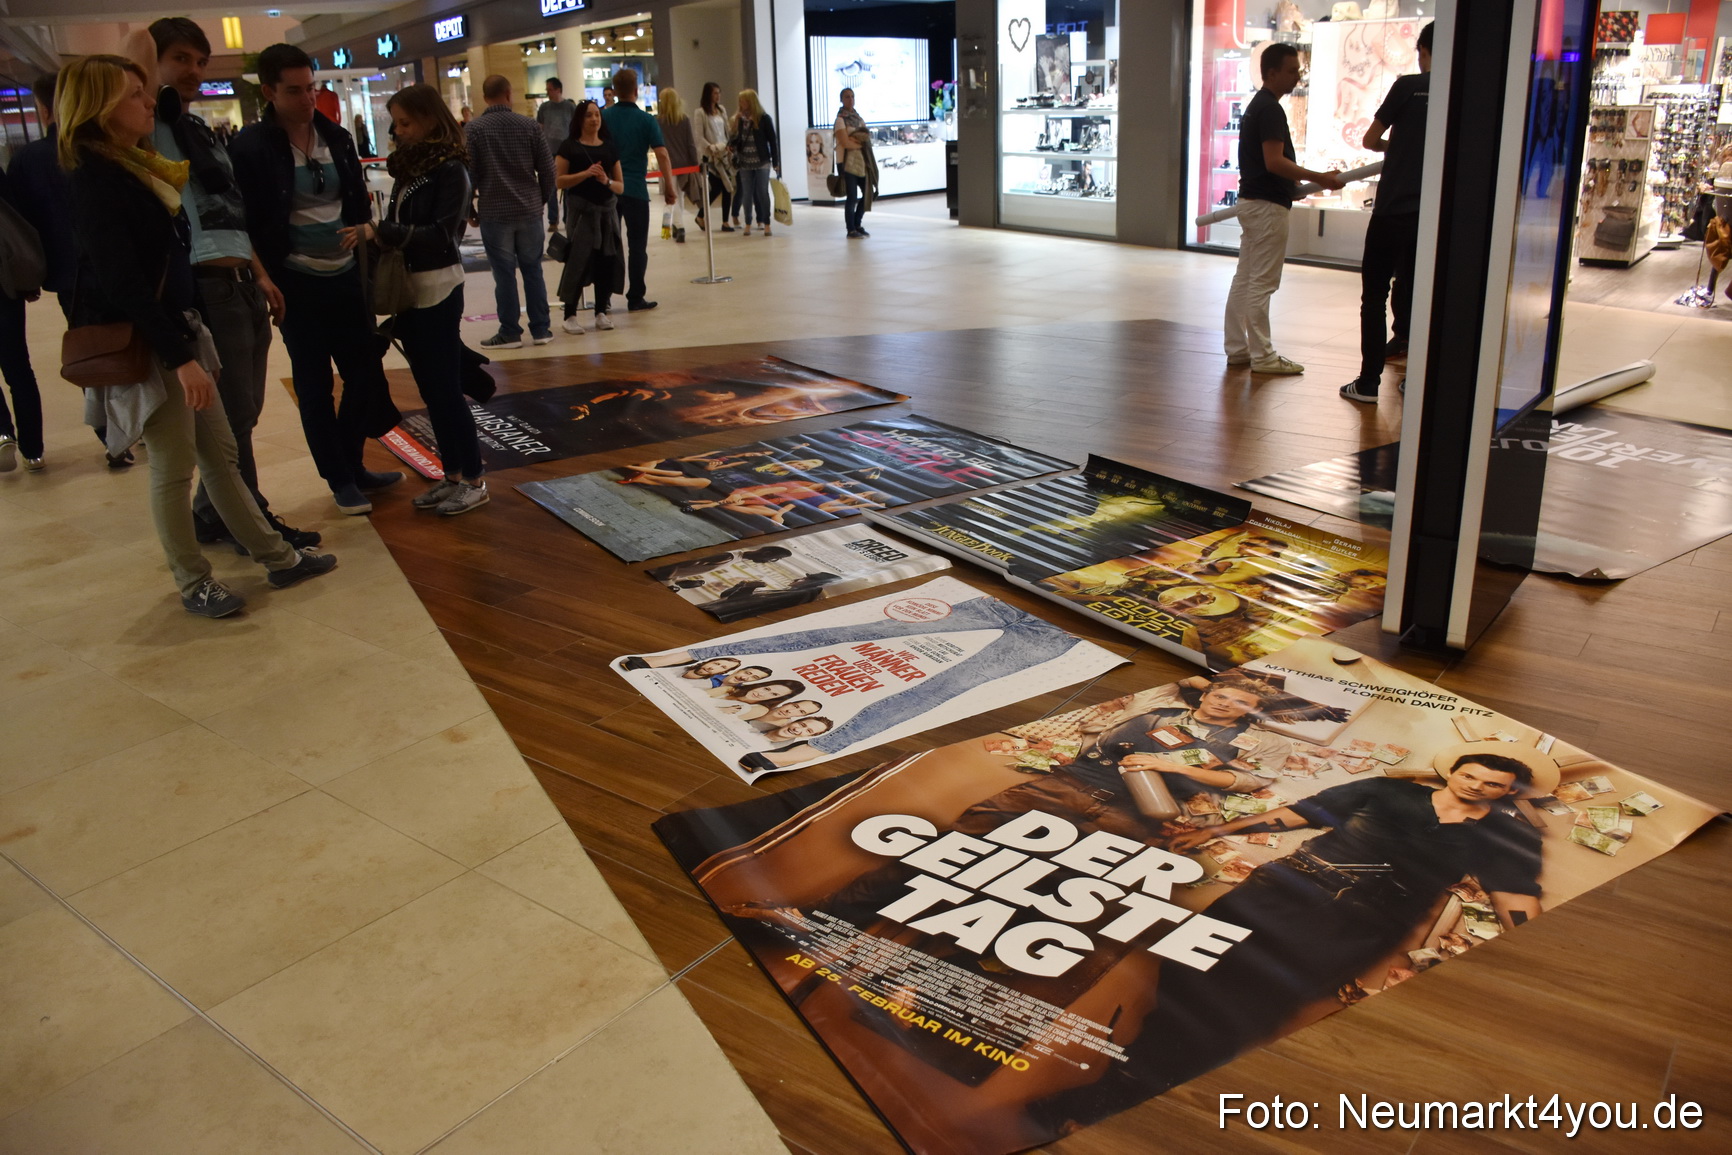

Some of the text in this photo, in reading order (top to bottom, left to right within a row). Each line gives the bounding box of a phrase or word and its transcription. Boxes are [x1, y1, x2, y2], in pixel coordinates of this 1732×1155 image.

[434, 16, 463, 40] DEPOT
[583, 67, 611, 80] POT
[838, 430, 995, 482] SINGLE
[882, 428, 938, 450] HOW
[936, 444, 965, 459] TO
[963, 457, 996, 470] BE
[851, 539, 909, 561] CREED
[1330, 545, 1358, 558] BUTLER
[1333, 538, 1362, 551] GERARD
[1085, 602, 1180, 638] EGYPT
[1113, 597, 1195, 631] GODS
[812, 654, 885, 693] FRAUEN
[851, 642, 927, 682] MÄNNER
[852, 659, 883, 676] ÜBER
[896, 649, 920, 663] WIE
[792, 664, 856, 697] REDEN
[1265, 663, 1458, 703] MATTHIAS SCHWEIGHÖFER
[1343, 687, 1495, 718] FLORIAN DAVID FITZ
[983, 809, 1204, 900] DER
[851, 814, 1253, 972] GEILSTE
[876, 874, 1095, 977] TAG
[785, 953, 1030, 1072] AB 25. FEBRUAR IM KINO
